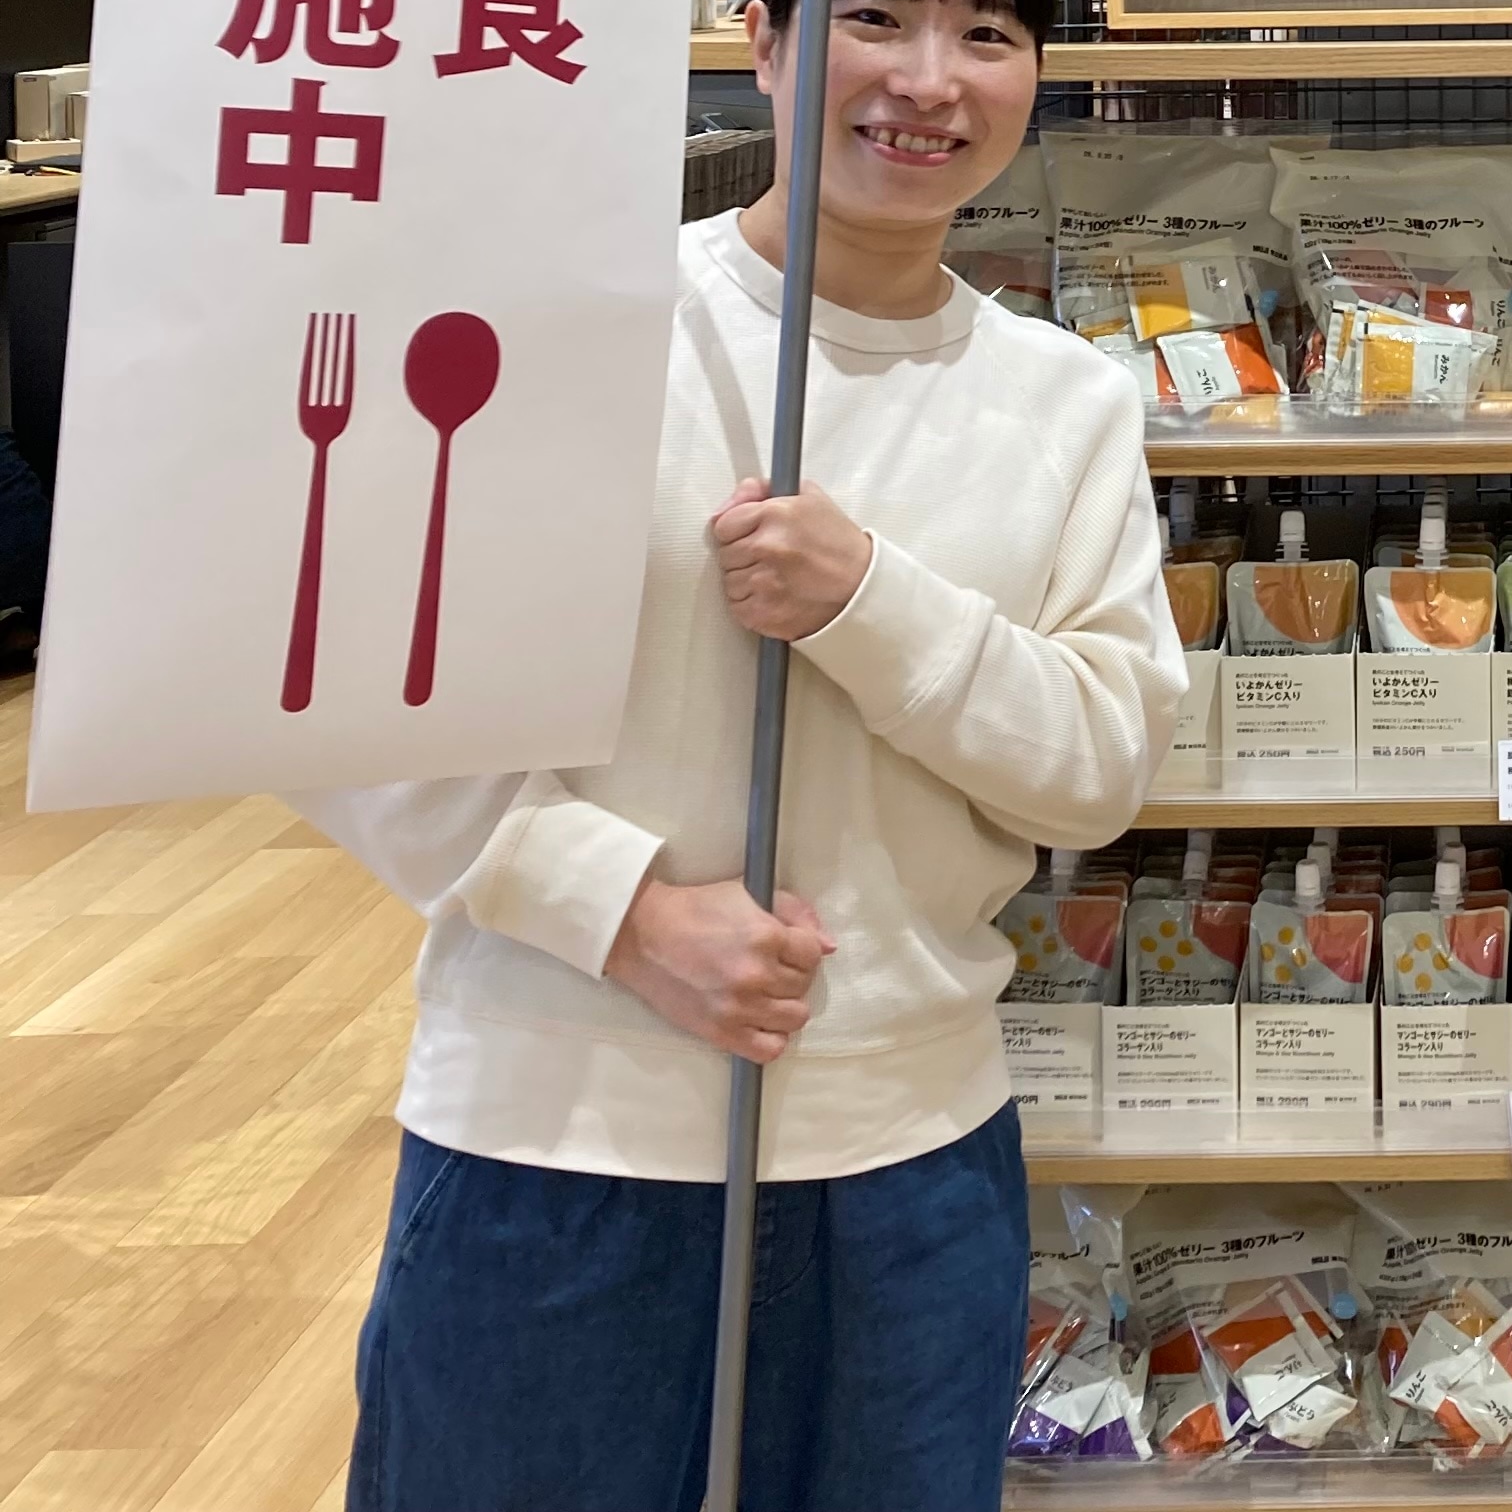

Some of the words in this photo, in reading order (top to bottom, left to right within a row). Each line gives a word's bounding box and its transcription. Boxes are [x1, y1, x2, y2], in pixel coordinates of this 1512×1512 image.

[954, 207, 1040, 221] 3種のフルーツ
[1060, 215, 1158, 234] 果汁100%ゼリー
[1163, 216, 1247, 231] 3種のフルーツ
[1236, 680, 1303, 690] いよかんゼリー
[1372, 677, 1439, 687] いよかんゼリー
[1237, 691, 1301, 702] ビタミンC入り
[1373, 688, 1437, 698] ビタミンC入り
[1221, 1231, 1305, 1253] 3種のフルーツ
